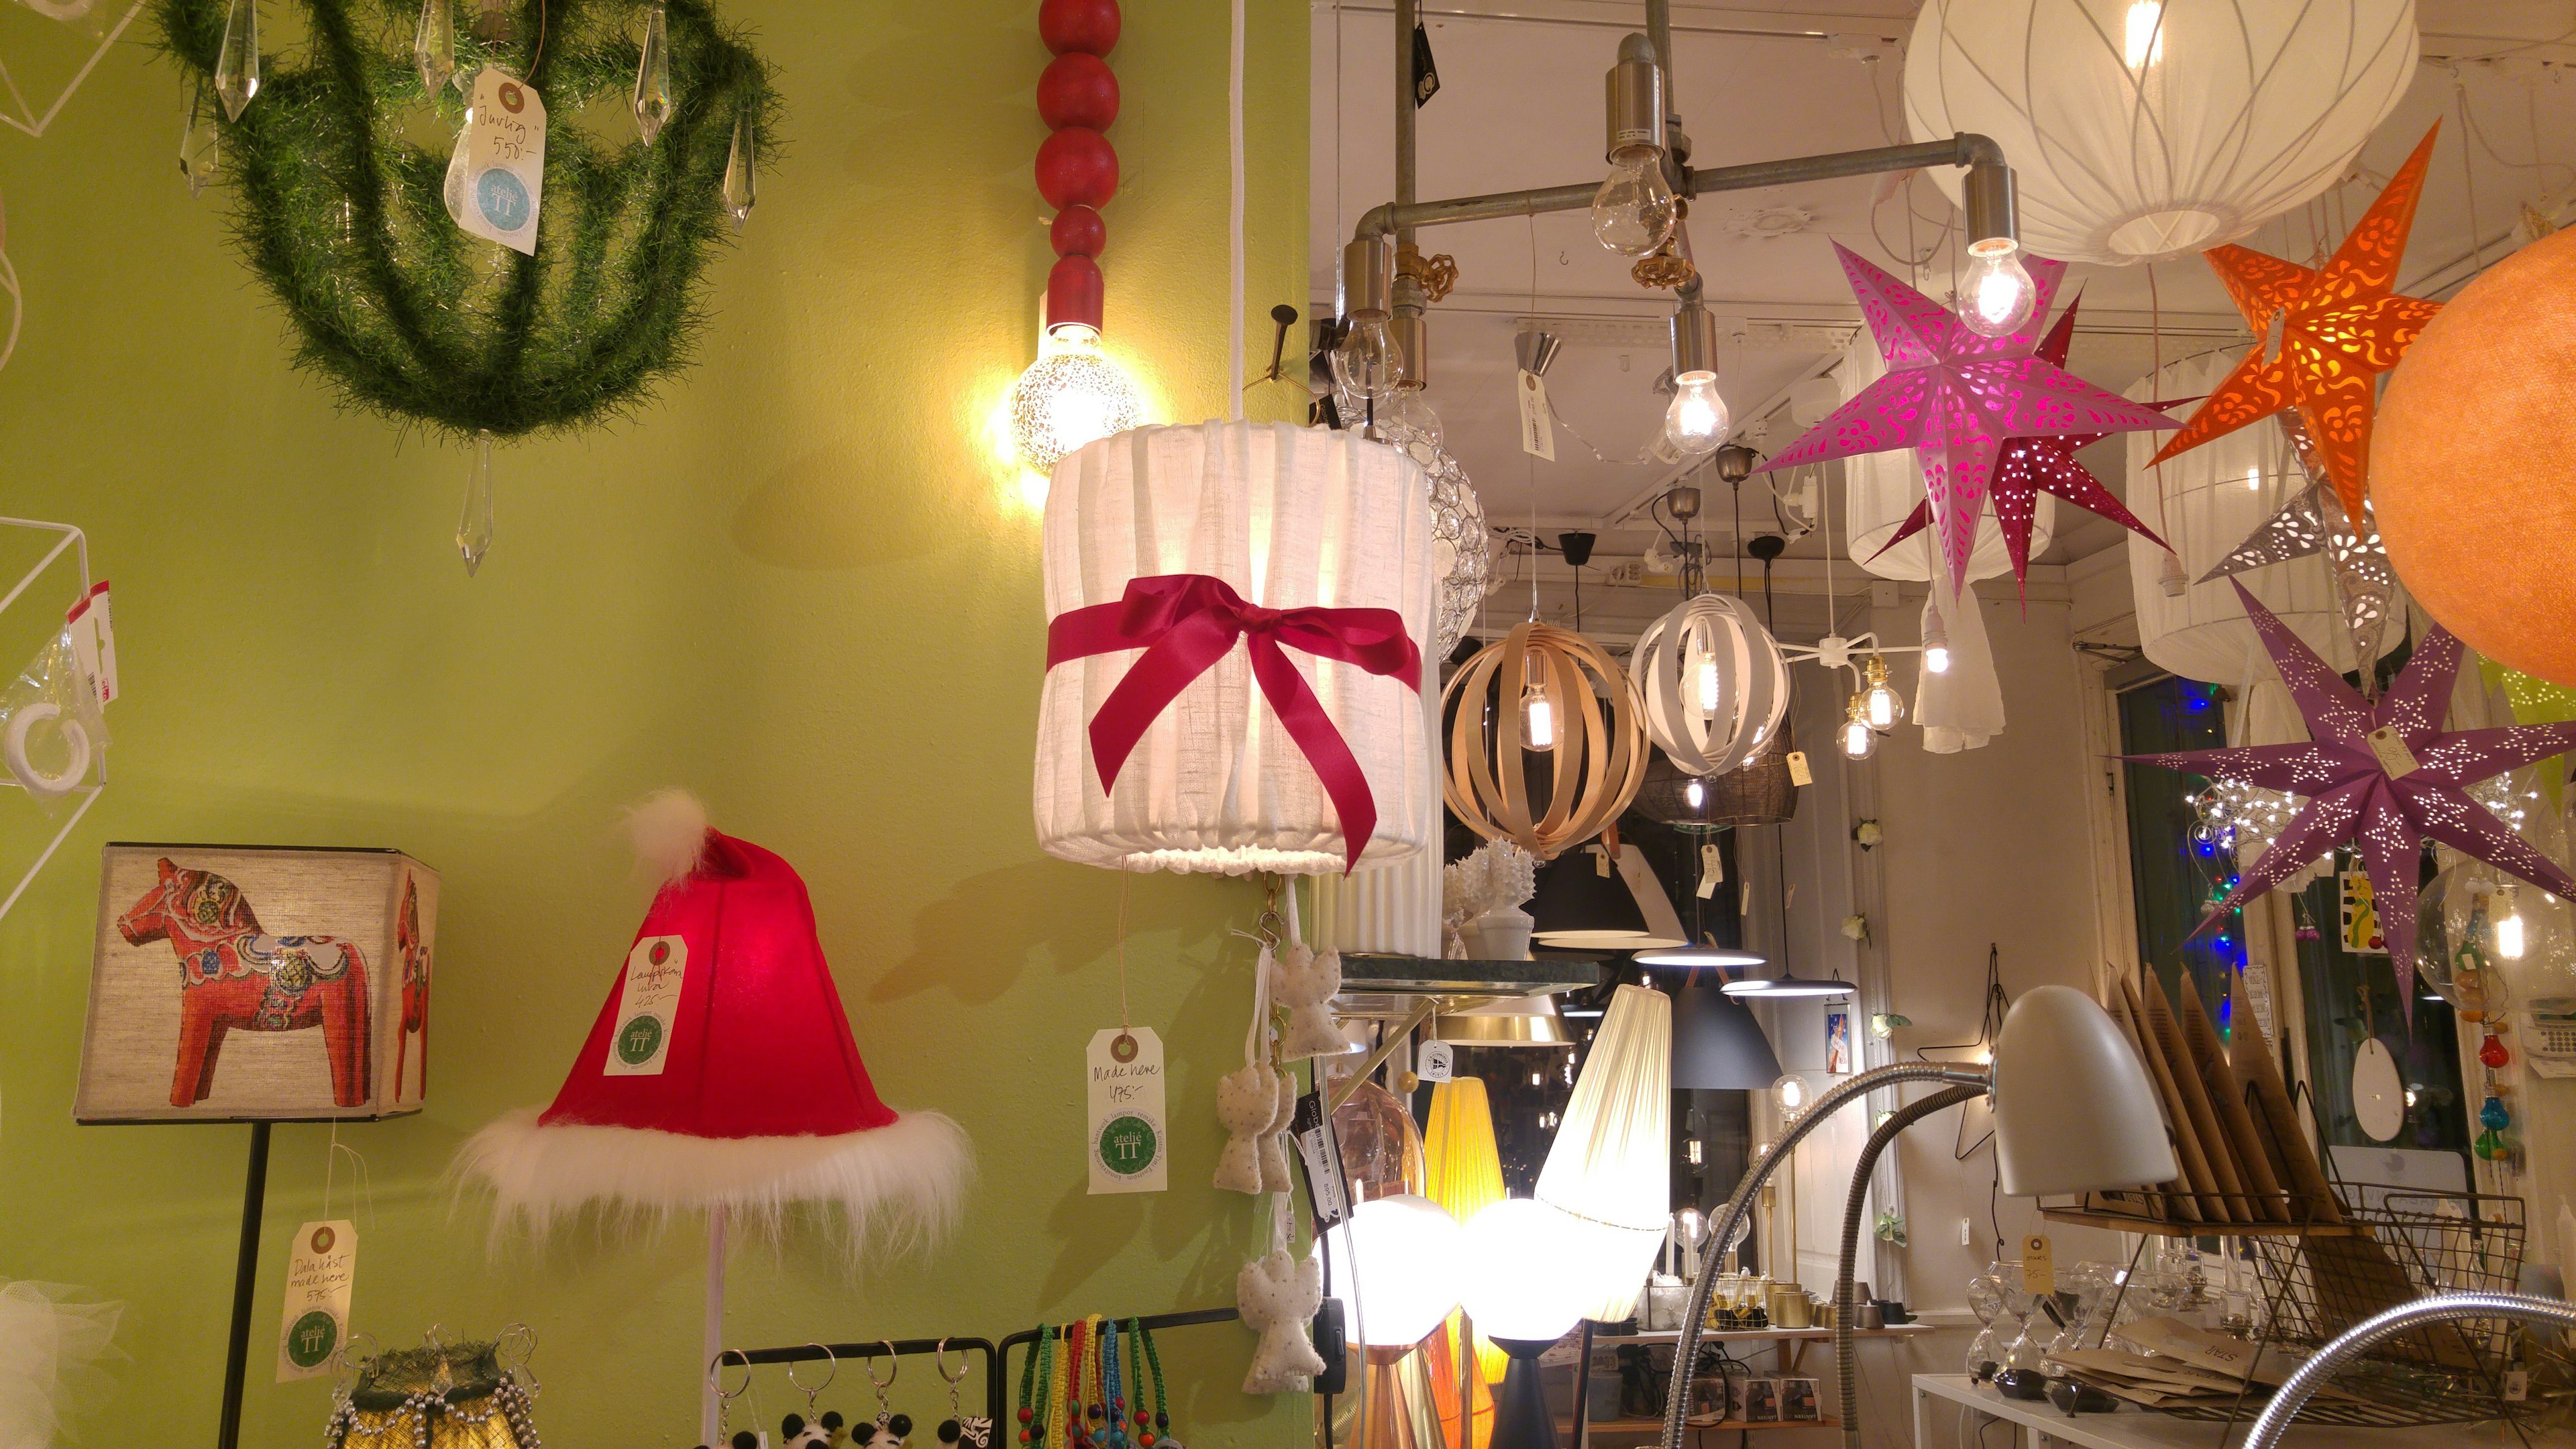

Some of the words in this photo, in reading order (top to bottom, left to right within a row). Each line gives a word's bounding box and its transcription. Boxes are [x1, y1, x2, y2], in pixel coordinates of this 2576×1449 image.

[490, 184, 519, 202] ateljé
[492, 192, 517, 217] TT
[630, 1028, 653, 1038] ateljé
[630, 1037, 651, 1052] TT
[1093, 1065, 1128, 1082] Made
[1130, 1064, 1161, 1077] here
[1093, 1118, 1110, 1144] hantverk
[1110, 1110, 1134, 1120] lampor
[1137, 1111, 1157, 1128] remake
[1155, 1130, 1164, 1153] Kristin
[1114, 1131, 1142, 1144] ateljé
[1115, 1142, 1140, 1161] TT
[290, 1275, 319, 1289] made
[321, 1273, 350, 1285] here
[300, 1325, 326, 1339] ateljé
[301, 1335, 324, 1354] TT
[2204, 1344, 2239, 1362] STAR
